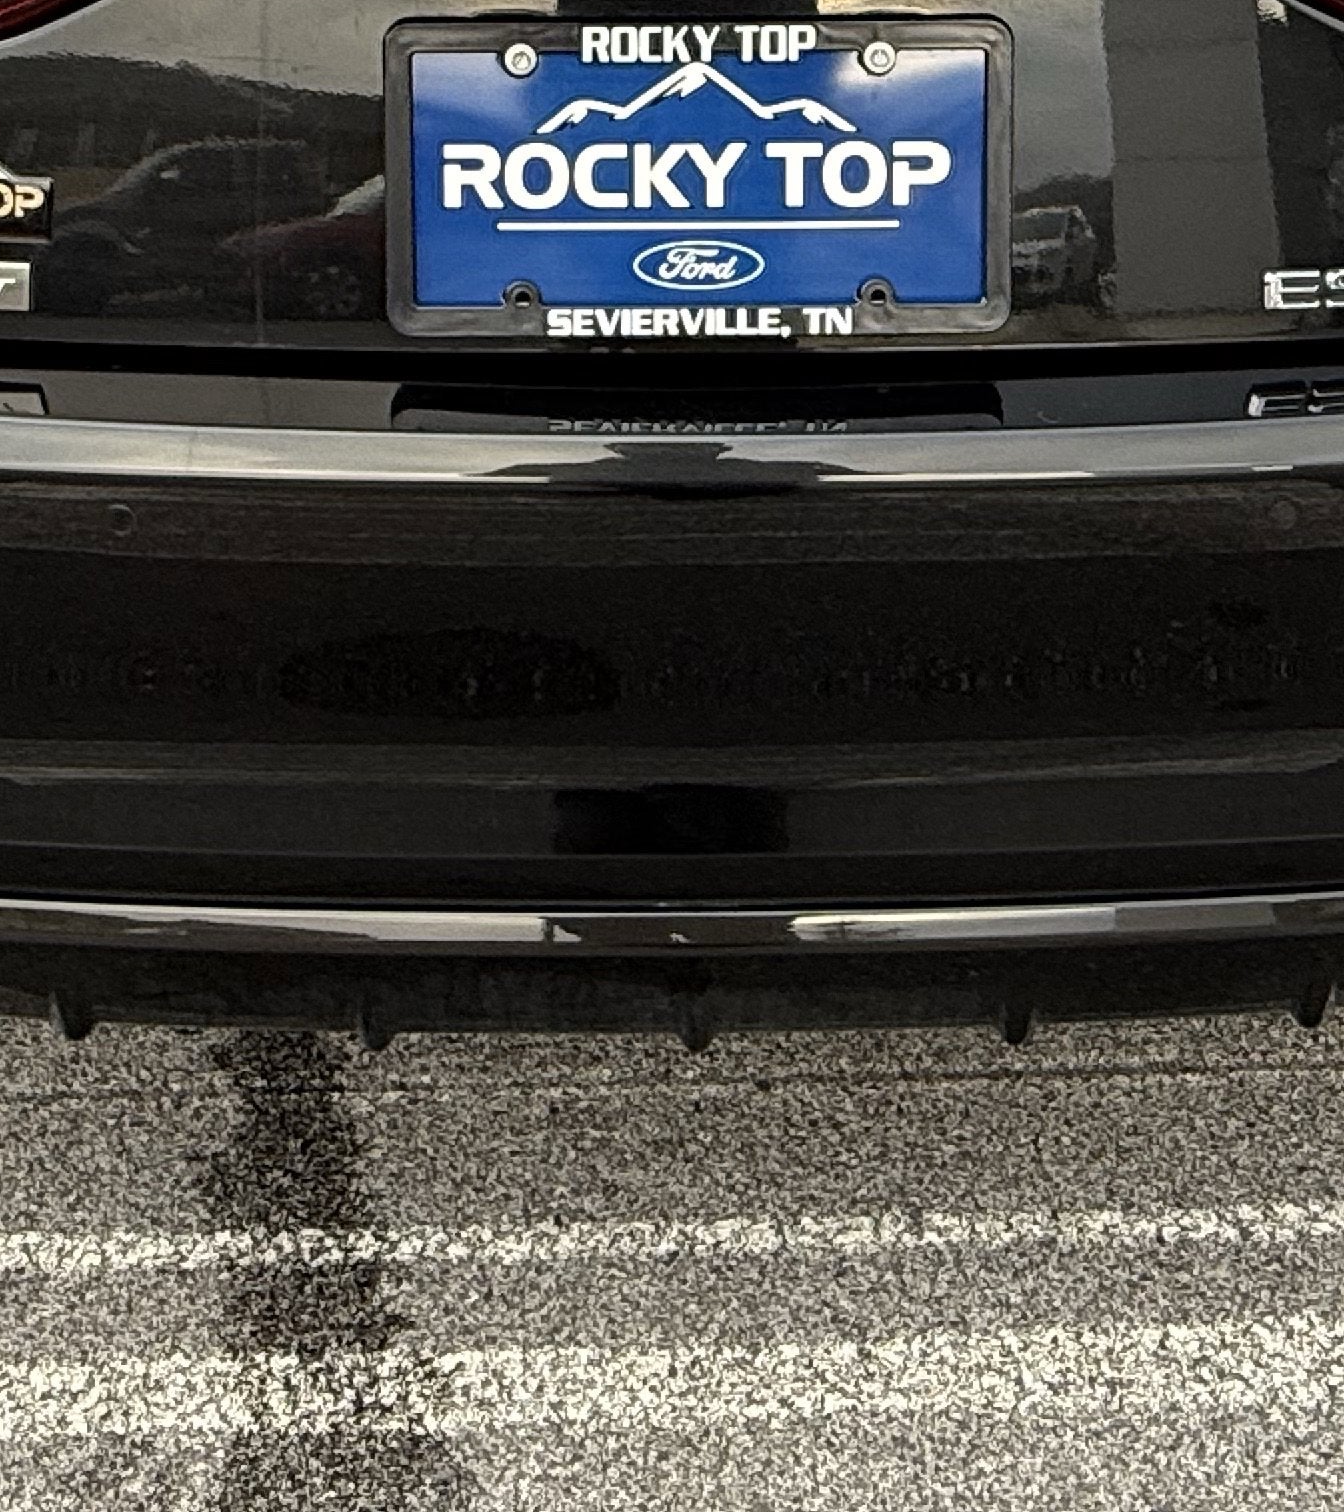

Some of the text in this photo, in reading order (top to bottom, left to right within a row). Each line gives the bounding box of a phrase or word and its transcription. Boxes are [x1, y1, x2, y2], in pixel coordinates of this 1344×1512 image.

[581, 24, 817, 64] ROCKY TOP
[442, 140, 952, 210] ROCKY TOP
[658, 248, 738, 281] Ford
[546, 306, 853, 339] SEVIERVILLE, TN
